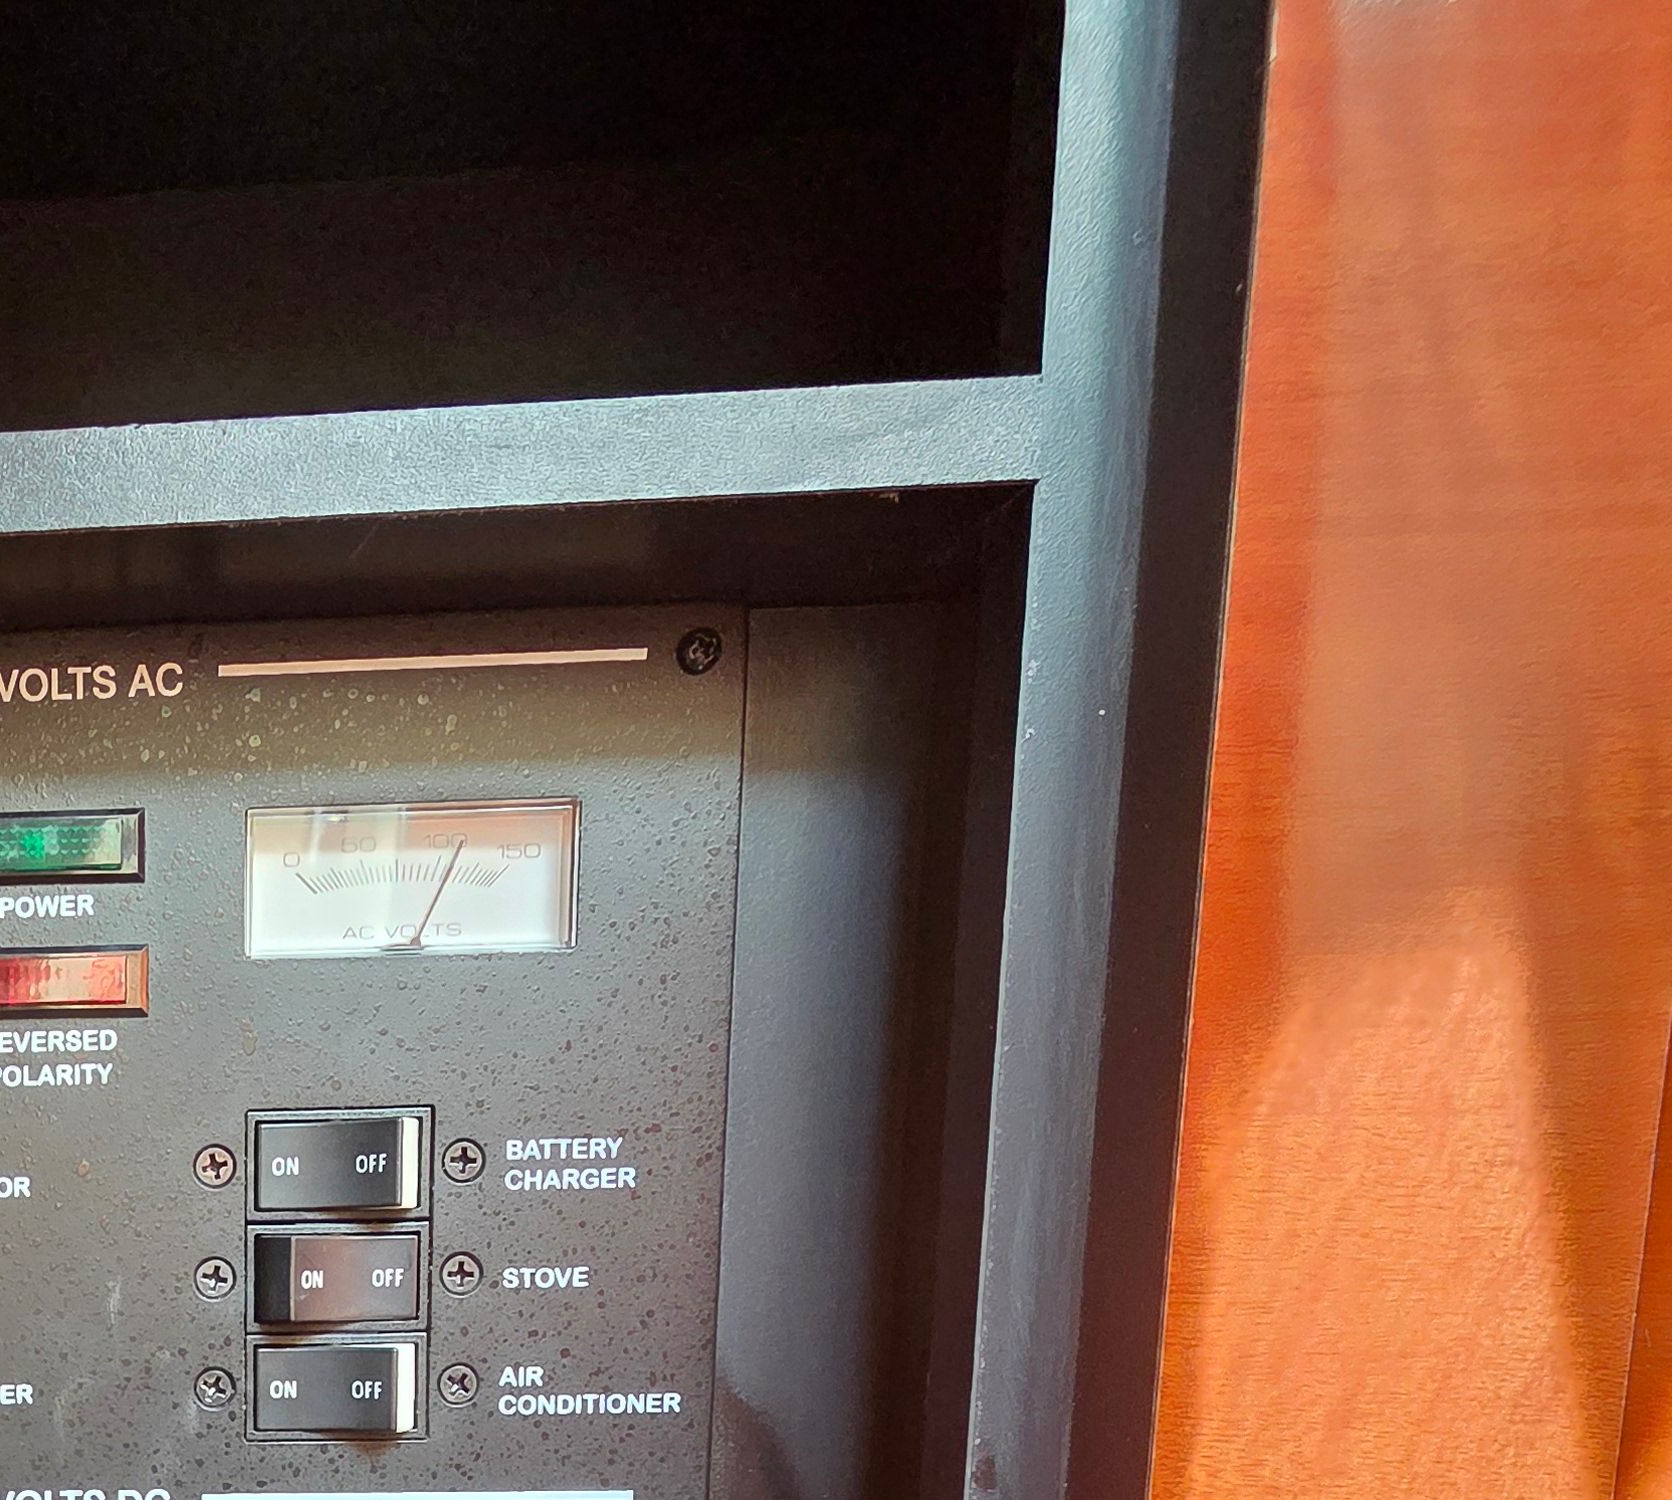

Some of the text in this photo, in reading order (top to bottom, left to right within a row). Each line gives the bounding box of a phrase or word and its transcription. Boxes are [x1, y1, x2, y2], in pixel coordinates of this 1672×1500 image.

[129, 663, 182, 697] AC
[424, 833, 468, 849] 100
[497, 843, 541, 859] 150
[0, 895, 94, 918] POWER
[342, 926, 375, 940] AC
[507, 1137, 622, 1160] BATTERY
[272, 1157, 298, 1176] ON
[356, 1154, 386, 1173] OFF
[505, 1167, 635, 1191] CHARGER
[302, 1271, 323, 1289] ON
[372, 1269, 403, 1287] OFF
[503, 1267, 589, 1288] STOVE
[499, 1367, 543, 1387] AIR
[270, 1381, 296, 1398] ON
[352, 1381, 381, 1399] OFF
[499, 1393, 681, 1415] CONDITIONER
